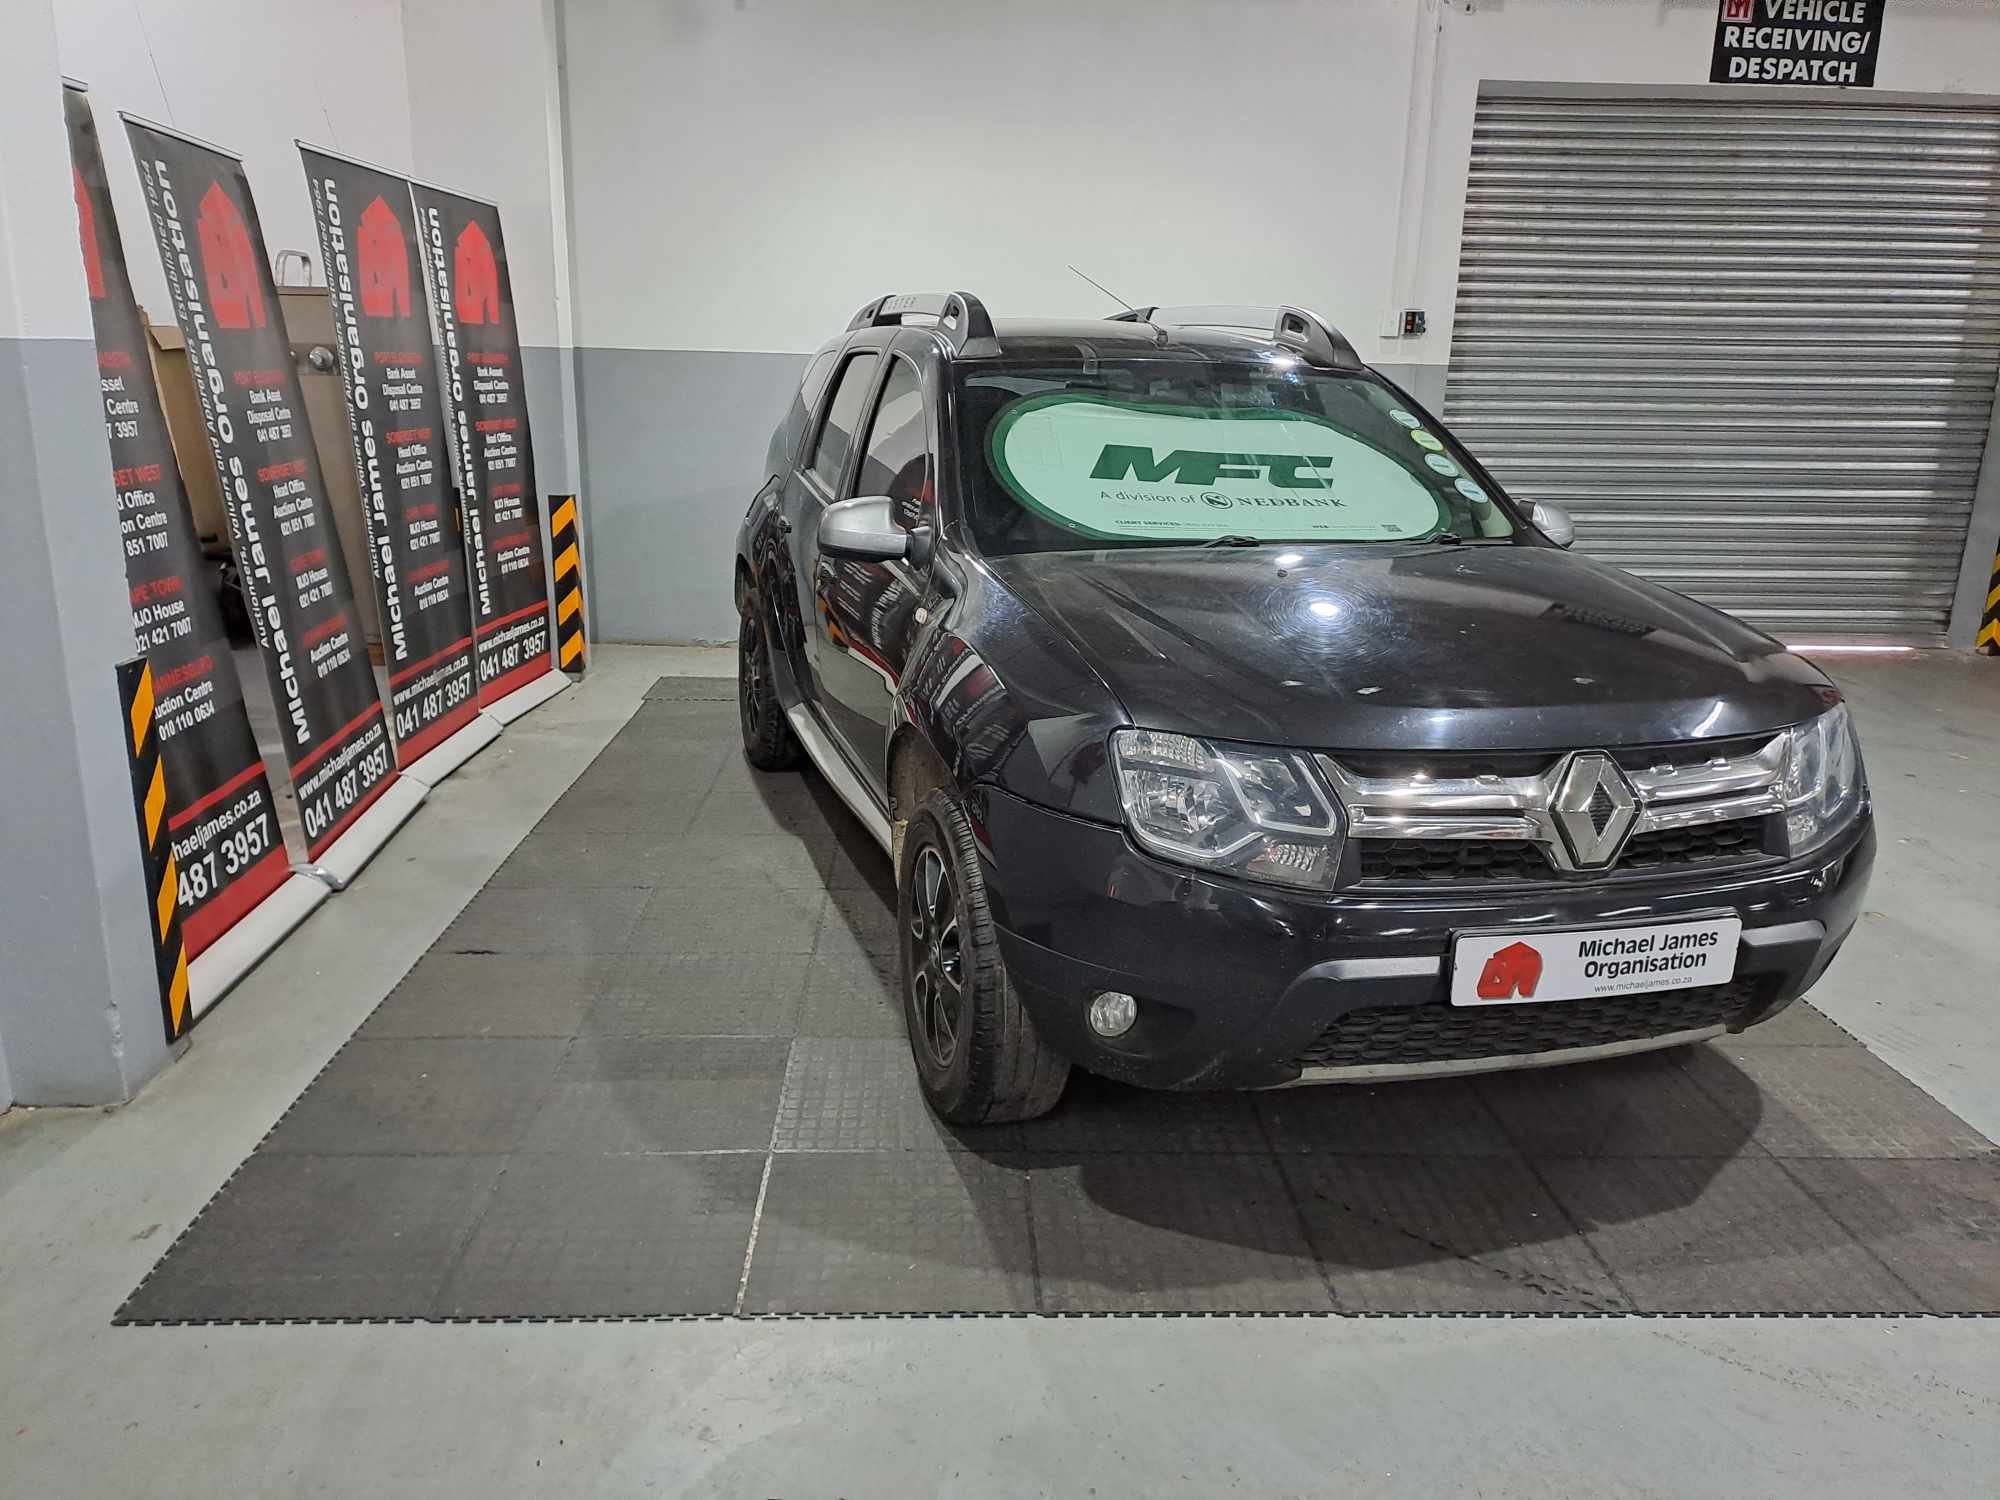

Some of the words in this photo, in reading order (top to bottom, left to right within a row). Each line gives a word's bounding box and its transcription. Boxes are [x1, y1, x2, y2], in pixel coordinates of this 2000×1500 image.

[1765, 0, 1867, 23] VEHICLE
[1723, 26, 1871, 54] RECEIVING/
[1729, 57, 1858, 82] DESPATCH
[150, 158, 237, 445] Organisation
[321, 177, 371, 410] Organisation
[426, 207, 464, 402] Organisation
[101, 376, 125, 392] sset
[106, 398, 139, 415] Centre
[358, 418, 387, 527] James
[455, 409, 477, 502] James
[1089, 444, 1334, 488] MFC
[125, 490, 155, 509] Office
[1100, 490, 1113, 501] A
[1115, 490, 1175, 504] division
[1181, 493, 1196, 504] of
[1238, 497, 1349, 508] NEDBANK
[136, 511, 168, 530] Centre
[225, 453, 272, 588] James
[126, 537, 146, 557] 851
[146, 531, 168, 551] 7007
[467, 507, 492, 615] Michael
[152, 600, 185, 621] House
[376, 534, 407, 661] Michael
[151, 625, 170, 645] 421
[260, 592, 311, 746] Michael
[480, 653, 500, 681] 041
[502, 643, 519, 669] 487
[522, 630, 546, 660] 3957
[155, 694, 185, 720] uction
[185, 680, 213, 703] Centre
[396, 703, 420, 738] 041
[422, 688, 443, 721] 487
[444, 671, 471, 708] 3957
[158, 720, 176, 741] 010
[176, 711, 194, 731] 110
[304, 792, 334, 838] 041
[335, 768, 359, 810] 487
[358, 742, 388, 788] 3957
[171, 790, 262, 862] haeljames.co.za
[178, 851, 218, 907] 487
[221, 812, 270, 875] 3957
[1579, 934, 1655, 958] Michael
[1660, 931, 1719, 951] James
[1584, 952, 1707, 979] Organisation
[1594, 976, 1693, 993] www.michaeljames.co.za
